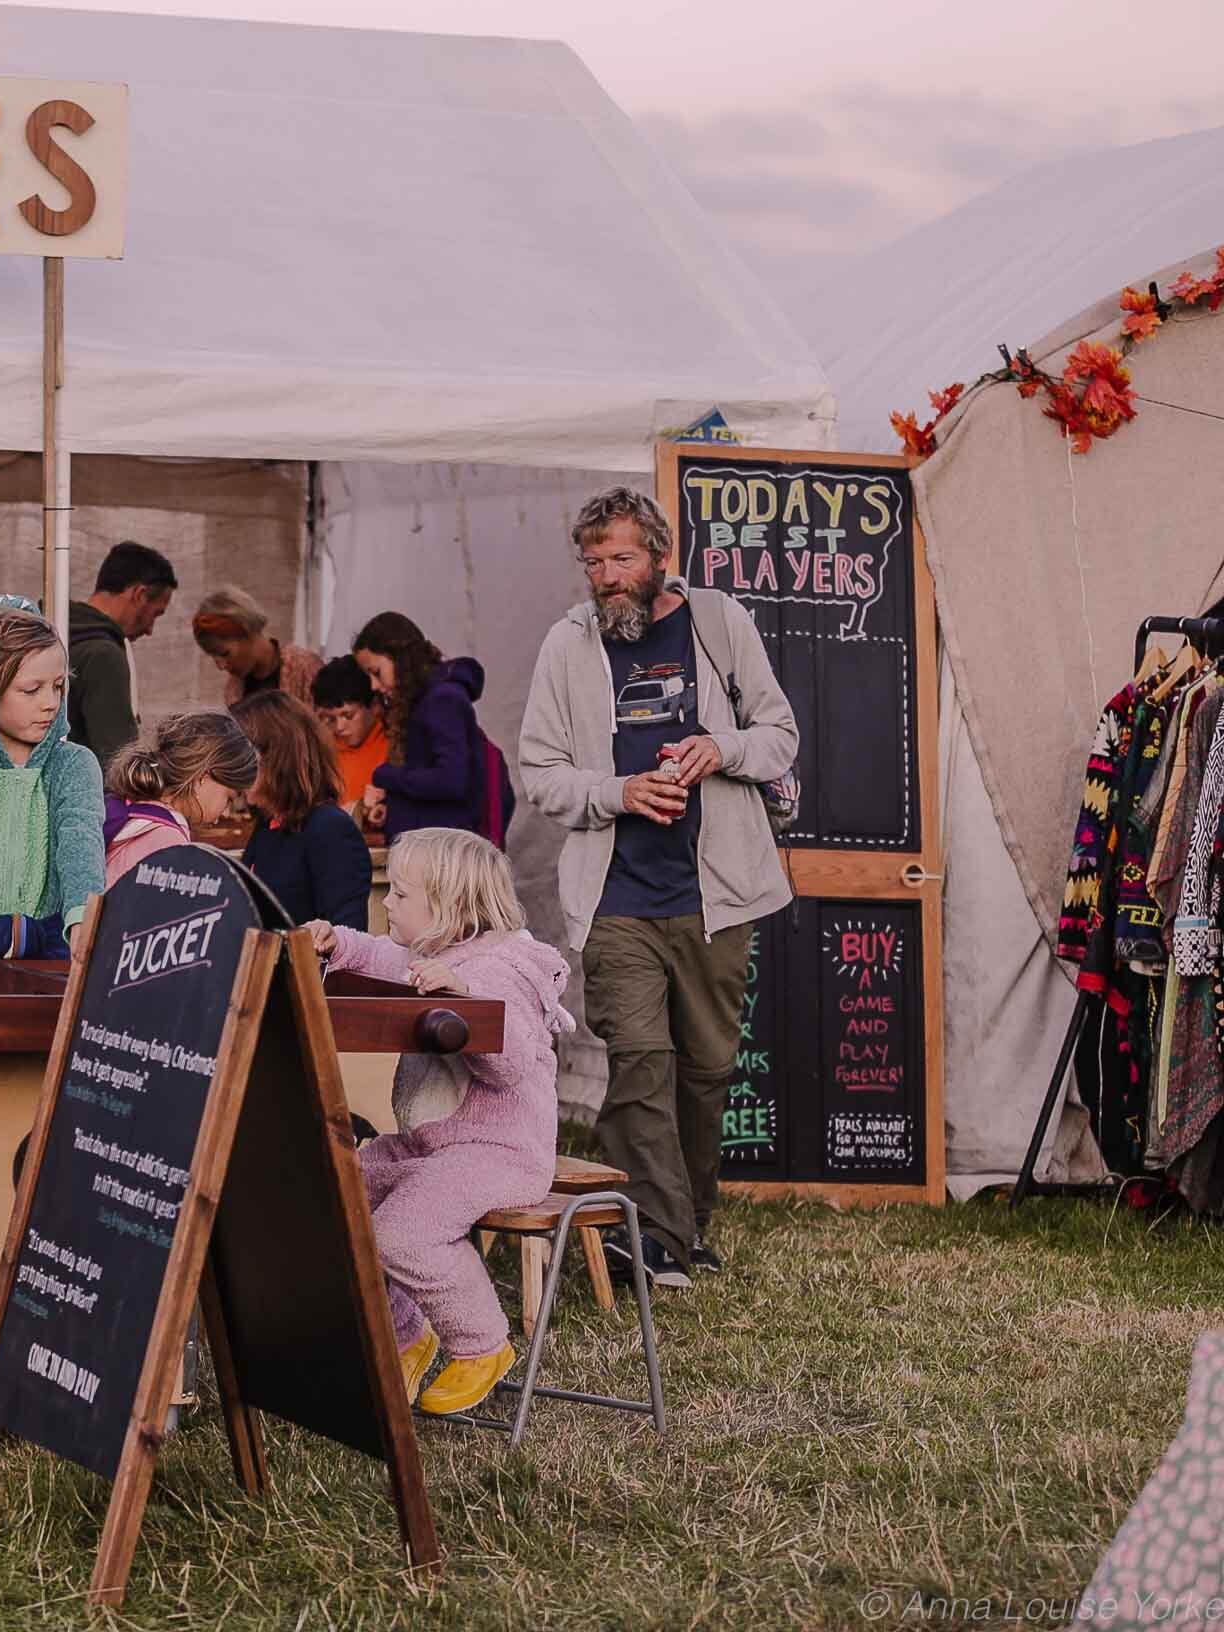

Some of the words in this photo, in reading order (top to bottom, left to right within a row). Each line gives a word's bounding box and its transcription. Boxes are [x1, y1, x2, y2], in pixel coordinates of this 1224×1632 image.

[687, 477, 891, 535] TODAY'S
[709, 522, 846, 554] BEST
[703, 547, 876, 599] PLAYERS
[136, 863, 156, 885] What
[174, 871, 201, 898] saying
[197, 873, 222, 897] about
[113, 911, 223, 985] PUCKET
[841, 933, 896, 966] BUY
[859, 967, 872, 990] A
[839, 995, 897, 1013] GAME
[846, 1019, 889, 1034] AND
[119, 1031, 134, 1052] for
[129, 1038, 150, 1061] every
[148, 1038, 173, 1068] family
[839, 1042, 889, 1063] PLAY
[834, 1064, 904, 1083] FOREVER!
[727, 1081, 757, 1097] OR
[722, 1107, 769, 1137] REE
[834, 1117, 862, 1133] DEALS
[836, 1131, 852, 1144] FOR
[108, 1142, 122, 1163] the
[121, 1186, 150, 1210] market
[146, 1189, 157, 1214] in
[75, 1255, 93, 1276] and
[86, 1263, 104, 1281] you
[27, 1341, 52, 1377] COME
[47, 1352, 62, 1382] IN
[57, 1358, 78, 1392] AND
[74, 1367, 101, 1404] PLAY
